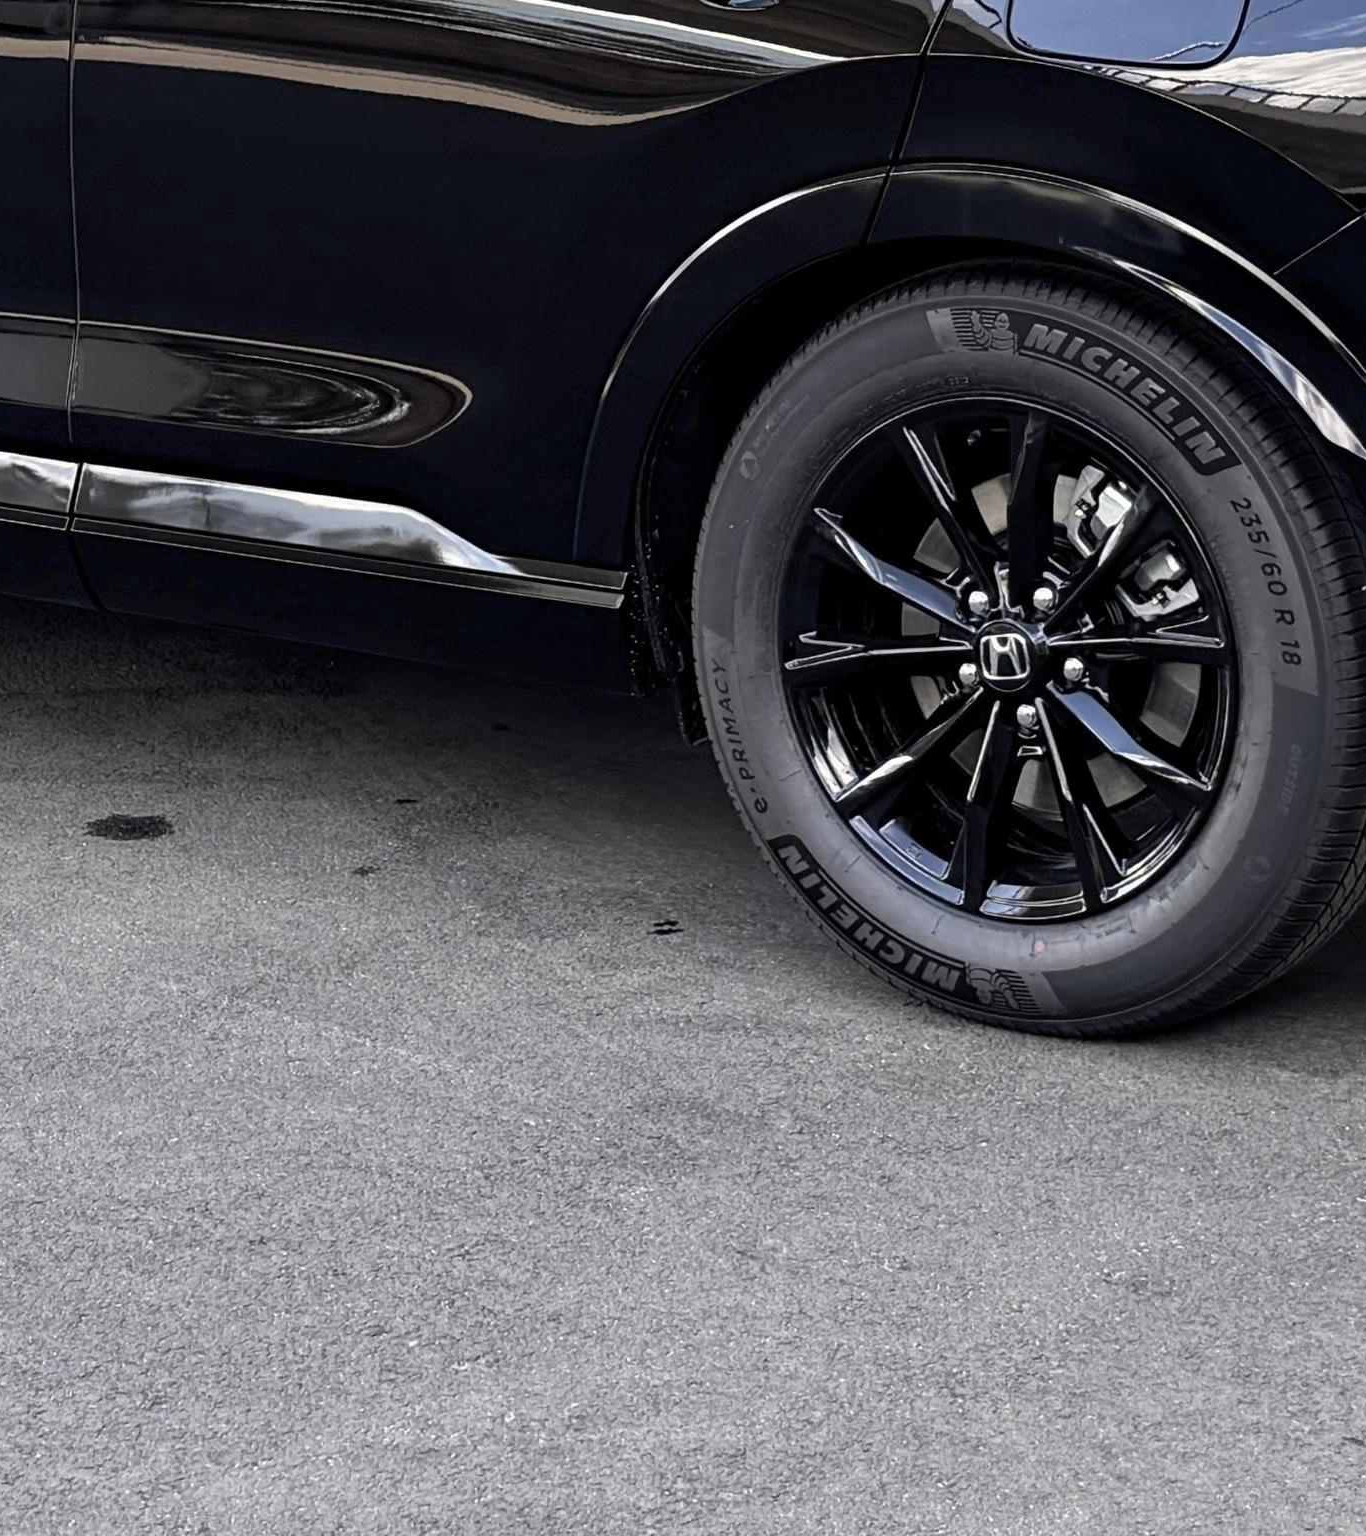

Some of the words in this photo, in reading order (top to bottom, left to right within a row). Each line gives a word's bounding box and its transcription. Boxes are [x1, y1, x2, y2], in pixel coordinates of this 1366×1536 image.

[1022, 322, 1227, 465] MICHELIN
[1229, 496, 1289, 597] 235/60
[1273, 607, 1296, 626] R
[1279, 639, 1302, 667] 18
[776, 844, 964, 993] MICHELIN
